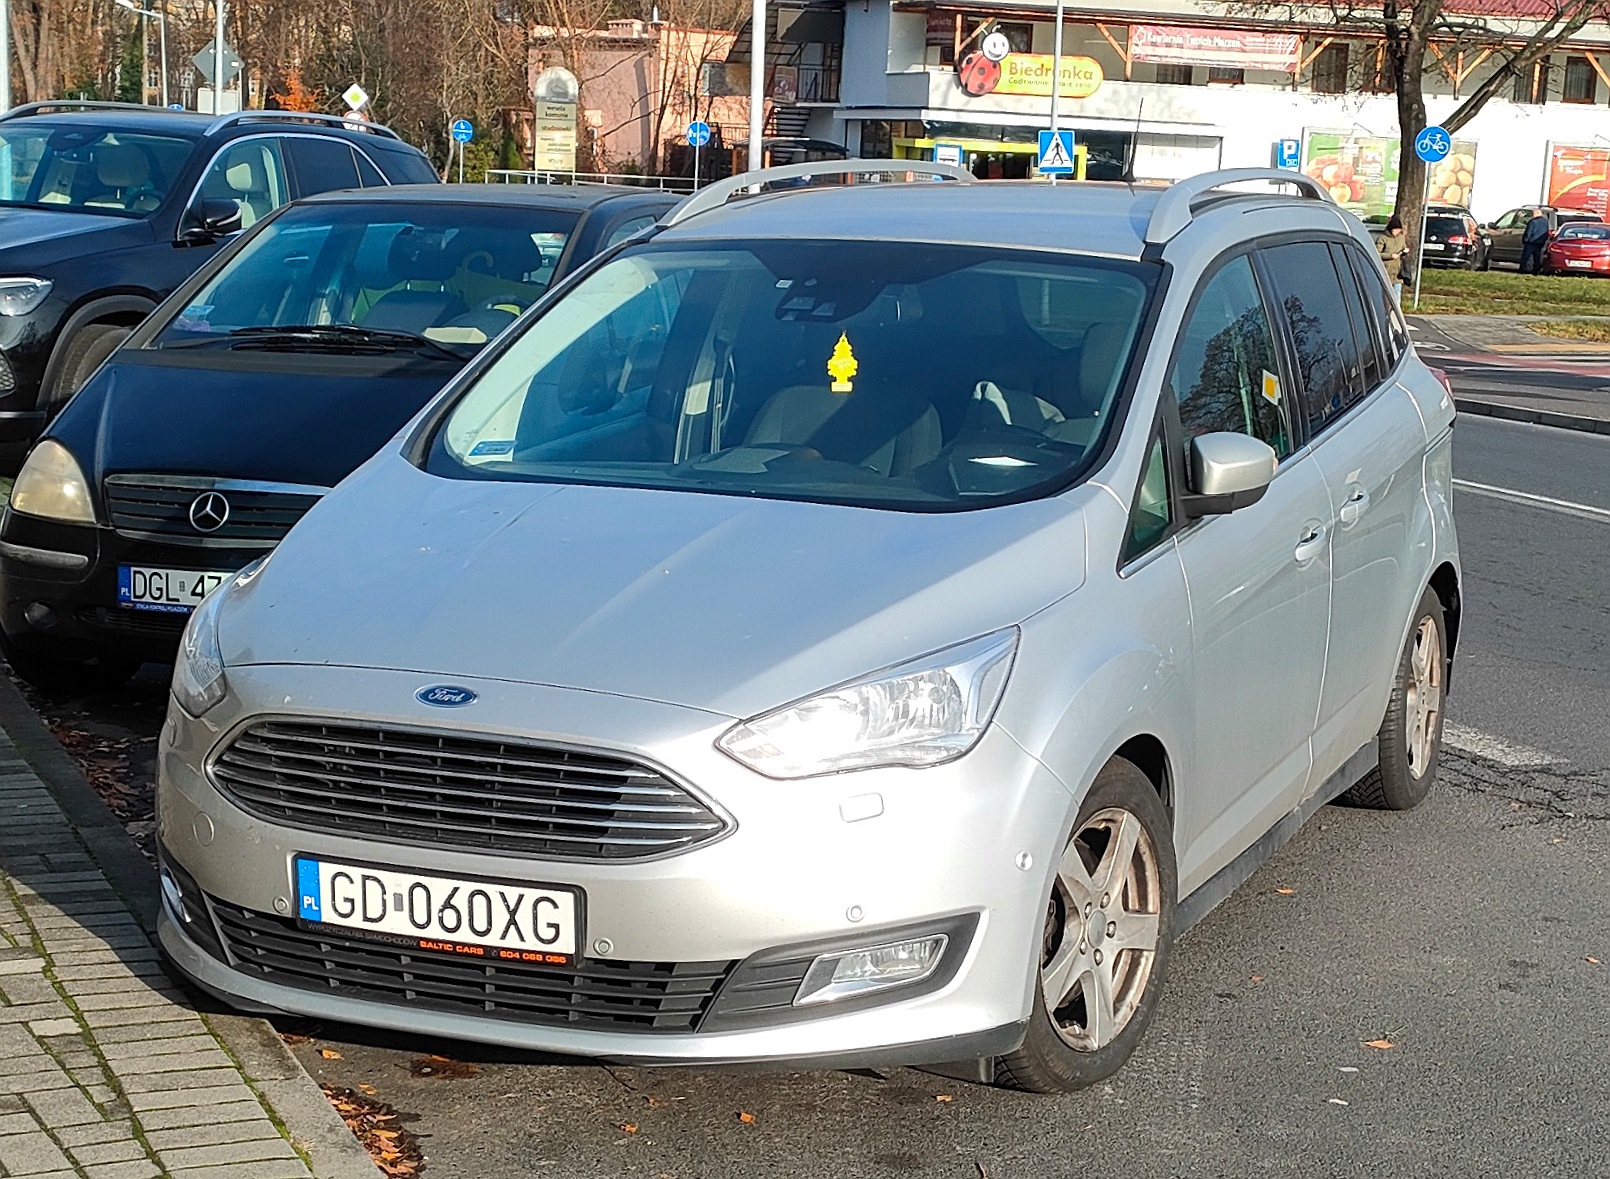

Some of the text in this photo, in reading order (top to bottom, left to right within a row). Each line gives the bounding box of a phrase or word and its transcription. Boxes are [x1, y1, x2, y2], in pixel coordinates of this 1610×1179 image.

[1008, 61, 1094, 81] Biedrnka
[1283, 141, 1297, 159] P
[120, 587, 131, 596] PL
[132, 570, 180, 603] DGL
[428, 687, 466, 703] Ford
[303, 896, 320, 911] PL
[330, 871, 561, 945] GD 060XG
[419, 940, 454, 951] BALTIC
[455, 945, 485, 956] CARS
[499, 950, 521, 959] 604
